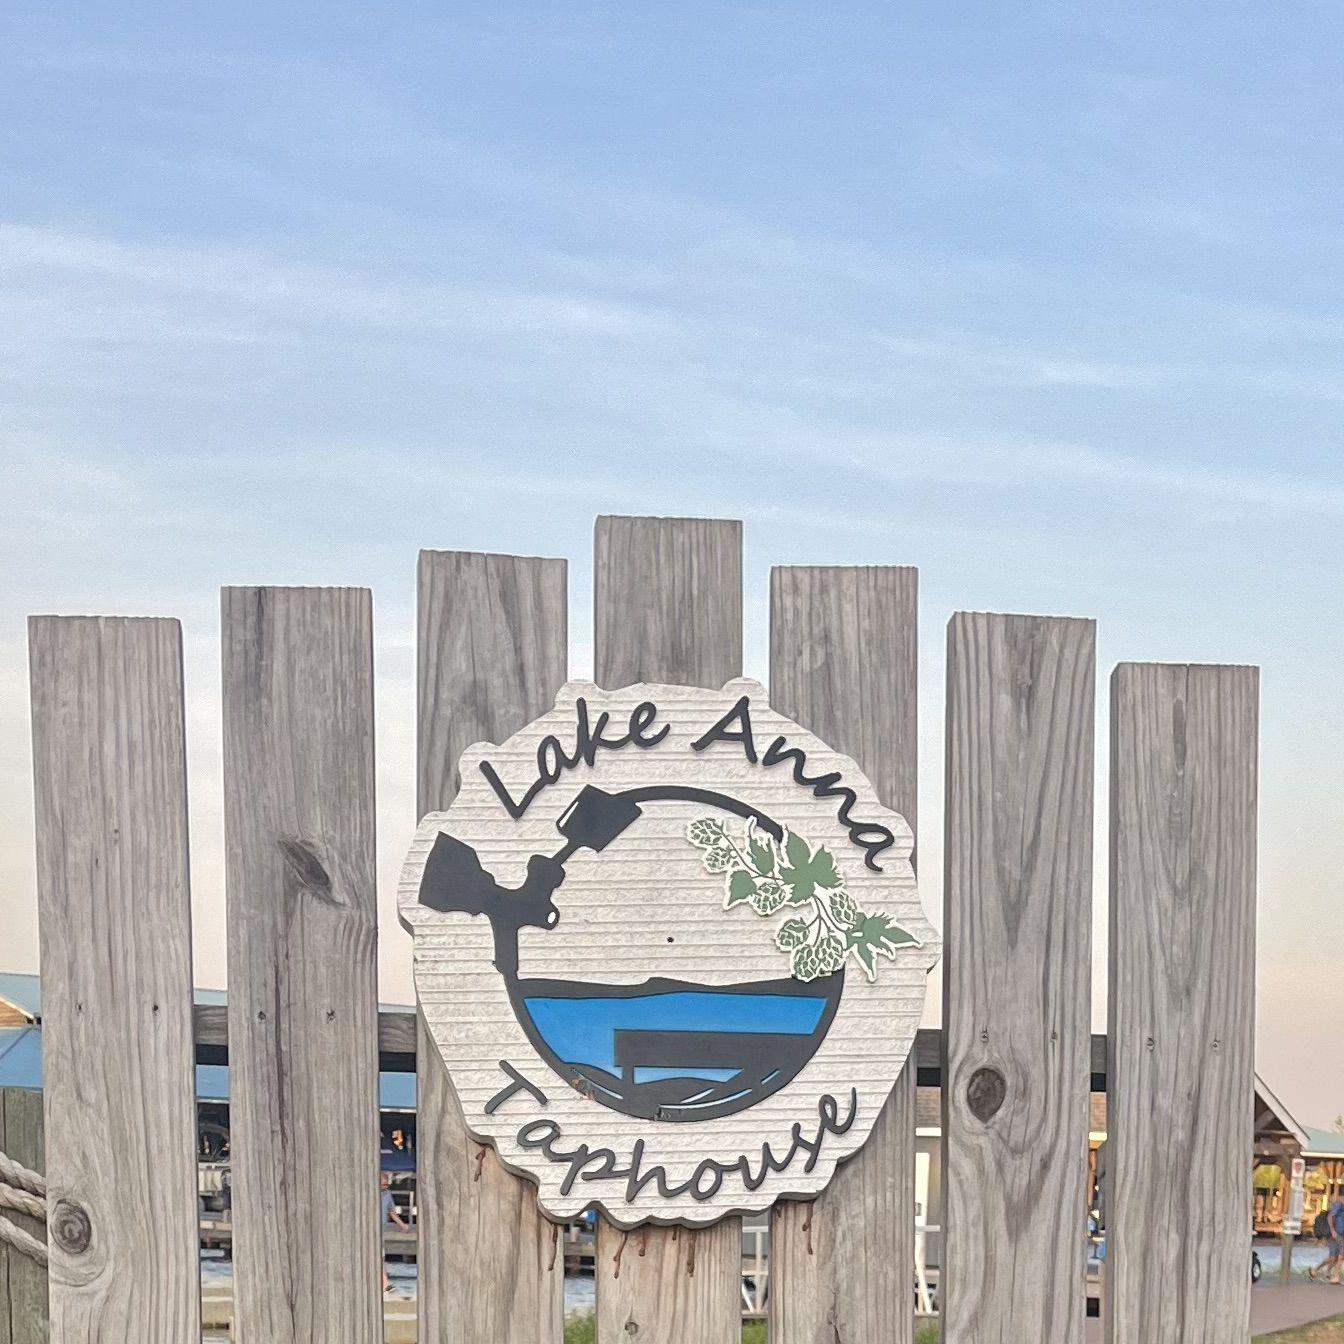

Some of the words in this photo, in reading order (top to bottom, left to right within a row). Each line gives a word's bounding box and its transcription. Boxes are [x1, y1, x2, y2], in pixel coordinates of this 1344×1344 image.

[479, 697, 671, 819] Lake
[691, 695, 895, 873] Anna
[484, 1059, 857, 1203] Taphouse
